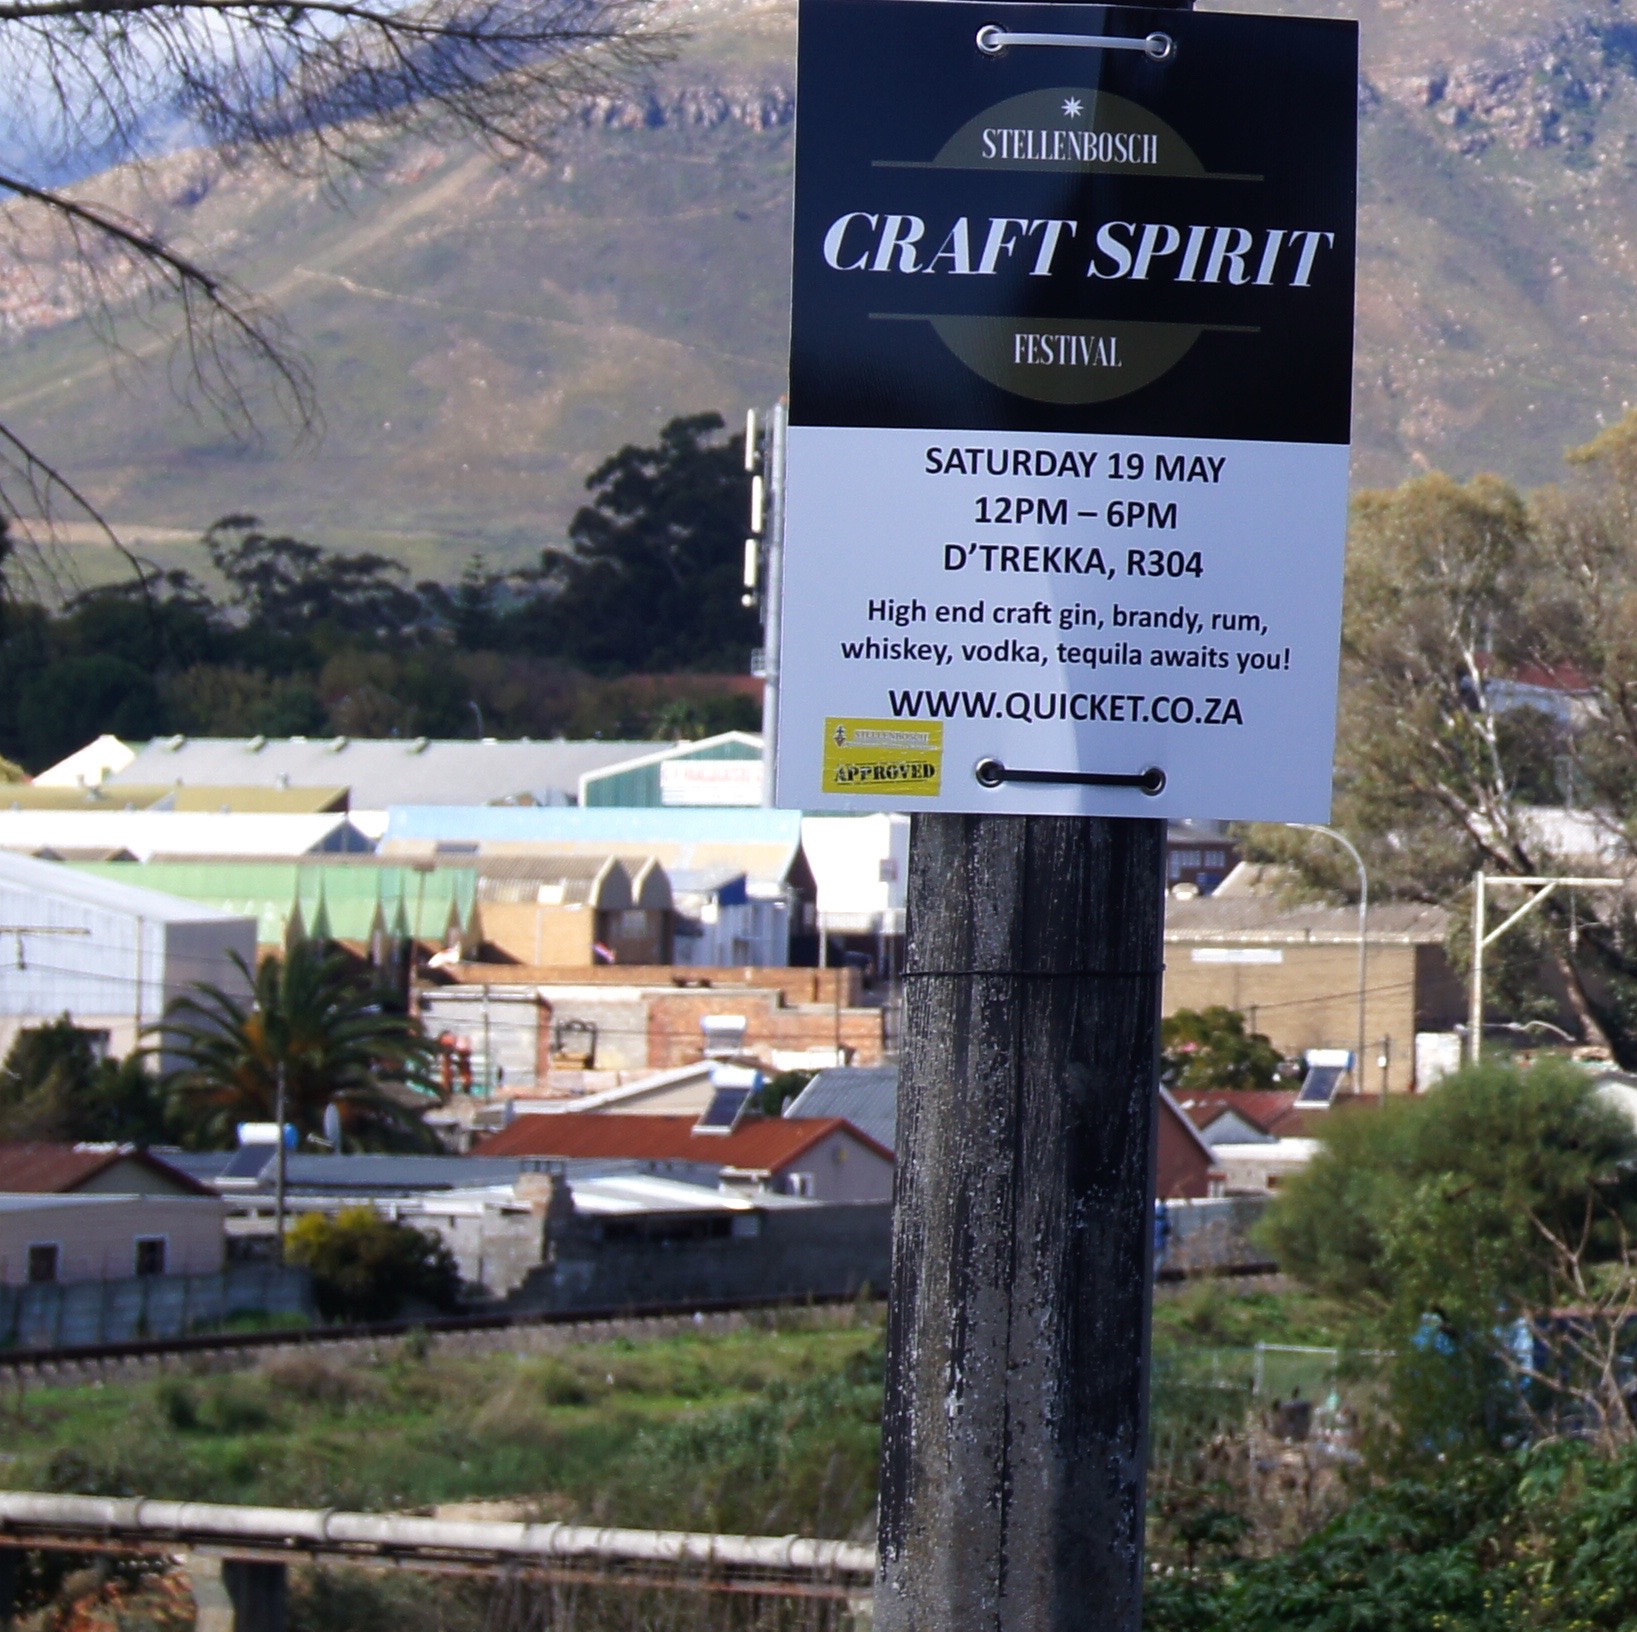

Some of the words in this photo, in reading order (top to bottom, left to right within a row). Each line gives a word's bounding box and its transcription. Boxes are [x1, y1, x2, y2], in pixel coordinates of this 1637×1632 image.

[982, 128, 1158, 164] STELLENBOSCH
[823, 212, 1076, 276] CRAFT
[1088, 221, 1334, 287] SPIRIT
[1014, 334, 1122, 367] FESTIVAL
[925, 447, 1097, 480] SATURDAY
[1107, 453, 1144, 480] 19
[1155, 455, 1226, 484] MAY
[975, 497, 1067, 526] 12PM
[1107, 502, 1177, 530] 6PM
[1127, 550, 1204, 578] R304
[868, 599, 926, 627] High
[935, 601, 984, 624] end
[992, 602, 1052, 625] craft
[1059, 605, 1104, 631] gin,
[1112, 605, 1204, 635] brandy,
[1212, 612, 1268, 635] rum,
[841, 637, 953, 666] whiskey,
[962, 642, 1048, 667] vodka,
[1056, 643, 1141, 669] tequila
[1150, 645, 1229, 668] awaits
[1237, 648, 1291, 674] you!
[889, 689, 1243, 725] WWW.QUICKET.CO.ZA
[835, 763, 936, 782] APPROVED
